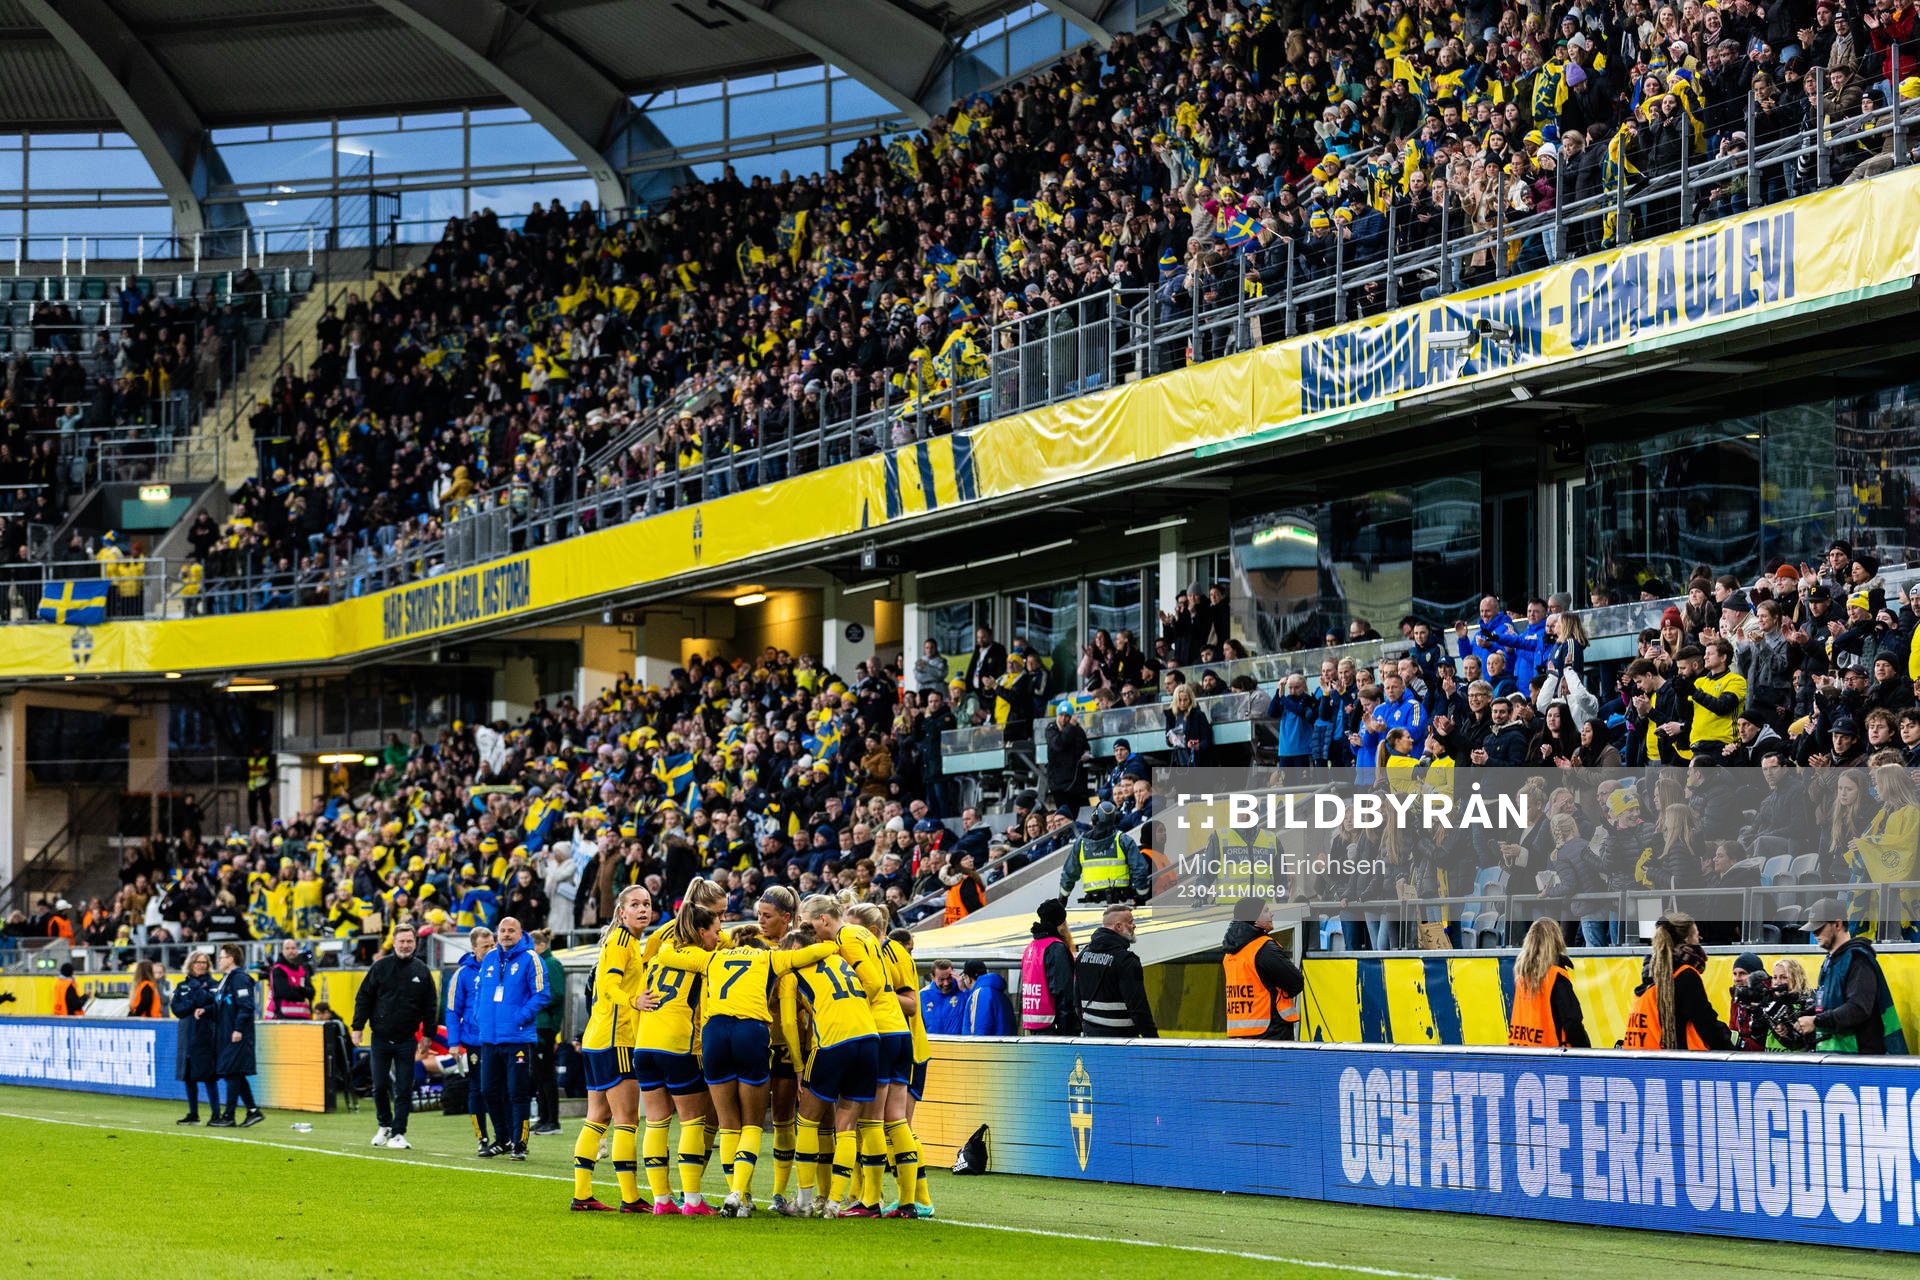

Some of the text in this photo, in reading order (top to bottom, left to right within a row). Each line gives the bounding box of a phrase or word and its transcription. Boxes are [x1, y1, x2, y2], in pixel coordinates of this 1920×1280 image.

[1571, 244, 1679, 351] GAMLA
[1685, 211, 1795, 320] ULLEVI
[482, 558, 530, 617] HISTORIA
[720, 960, 752, 999] 7
[1226, 984, 1254, 998] ERVICE
[1227, 1000, 1253, 1015] AFETY
[1339, 1067, 1421, 1187] OCH
[1431, 1072, 1504, 1193] ATT
[1514, 1072, 1573, 1199] GE
[1581, 1076, 1677, 1208] ERA
